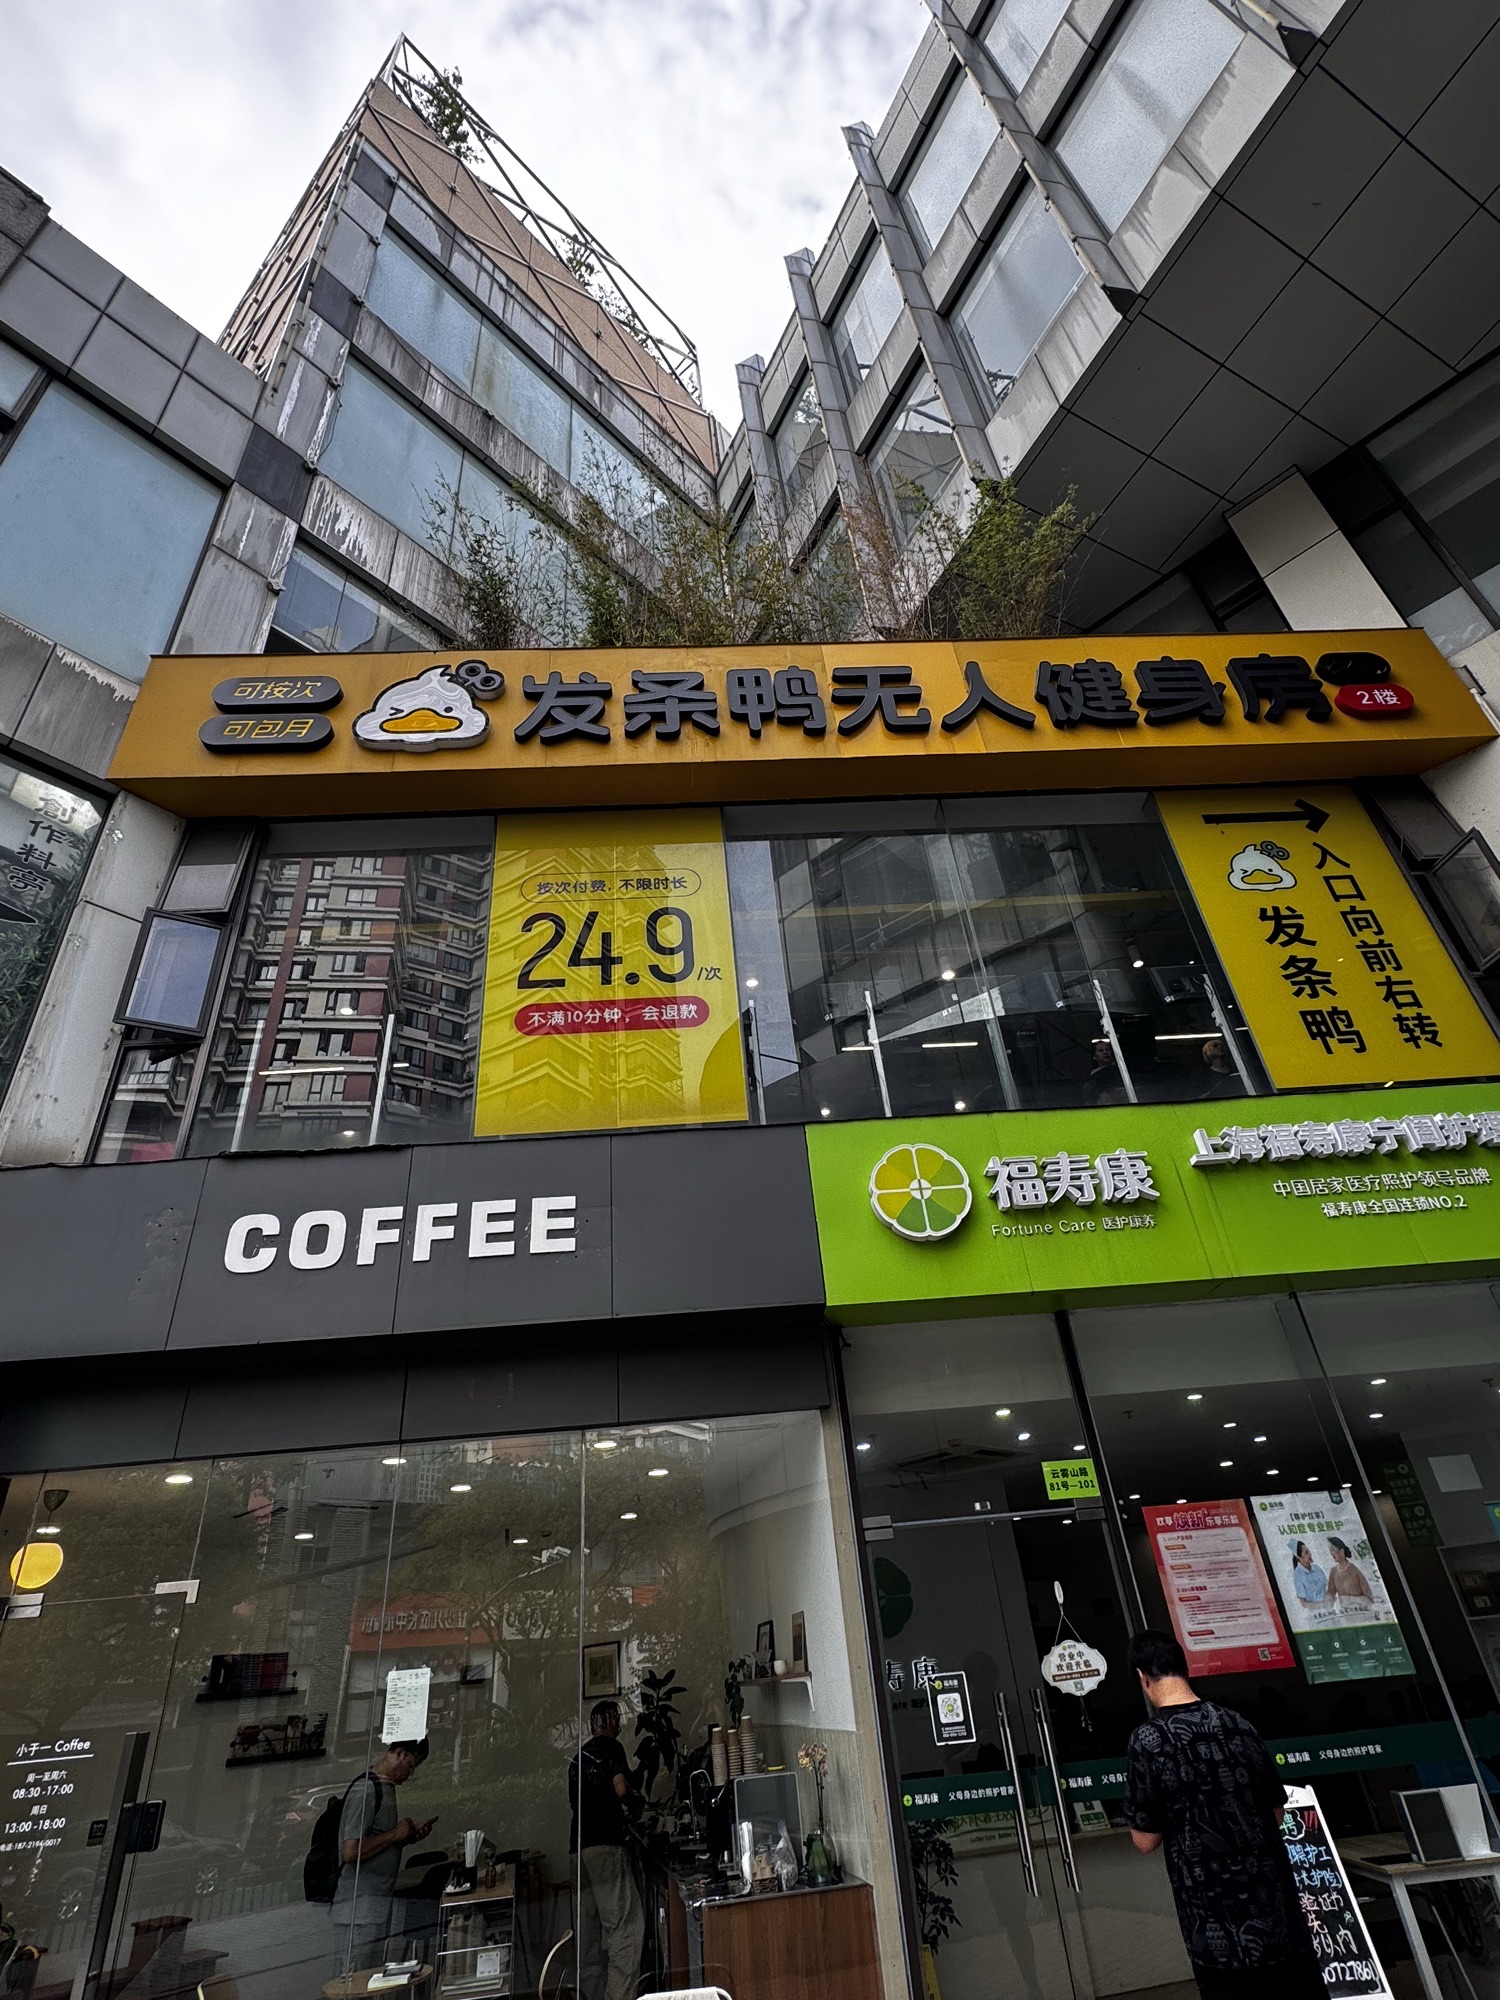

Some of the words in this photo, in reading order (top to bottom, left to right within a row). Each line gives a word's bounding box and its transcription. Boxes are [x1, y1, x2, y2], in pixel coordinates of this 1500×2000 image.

[233, 679, 322, 699] 可按次
[514, 653, 1333, 745] 发条鸭无人健身房
[1355, 688, 1402, 706] 2楼
[222, 717, 315, 740] 可包月
[516, 906, 695, 990] 24.9
[1312, 841, 1443, 1049] 入口向前右转
[1258, 905, 1368, 1055] 发条鸭
[983, 1148, 1160, 1212] 福寿康
[1273, 1167, 1493, 1198] 中国居家医疗照护领导品牌
[1321, 1194, 1468, 1219] 福寿康全国连锁NO.2
[224, 1195, 577, 1274] COFFEE
[991, 1222, 1053, 1237] Fortune
[1059, 1219, 1096, 1234] Care
[1101, 1213, 1157, 1231] 医护康养
[1050, 1466, 1089, 1479] 云雾山路
[1277, 1520, 1344, 1535] 认知症专业照护
[1056, 1659, 1092, 1672] 欢迎光临
[1058, 1650, 1084, 1662] 营业中
[16, 1743, 51, 1757] 小于一
[54, 1738, 91, 1752] Coffee
[1319, 1744, 1383, 1760] 父母身边的照护管家
[26, 1770, 67, 1783] 周一至周六
[1068, 1775, 1093, 1789] 福寿康
[914, 1792, 939, 1805] 福寿康
[948, 1785, 1016, 1802] 父母身边的照护管家
[30, 1804, 48, 1816] 周日
